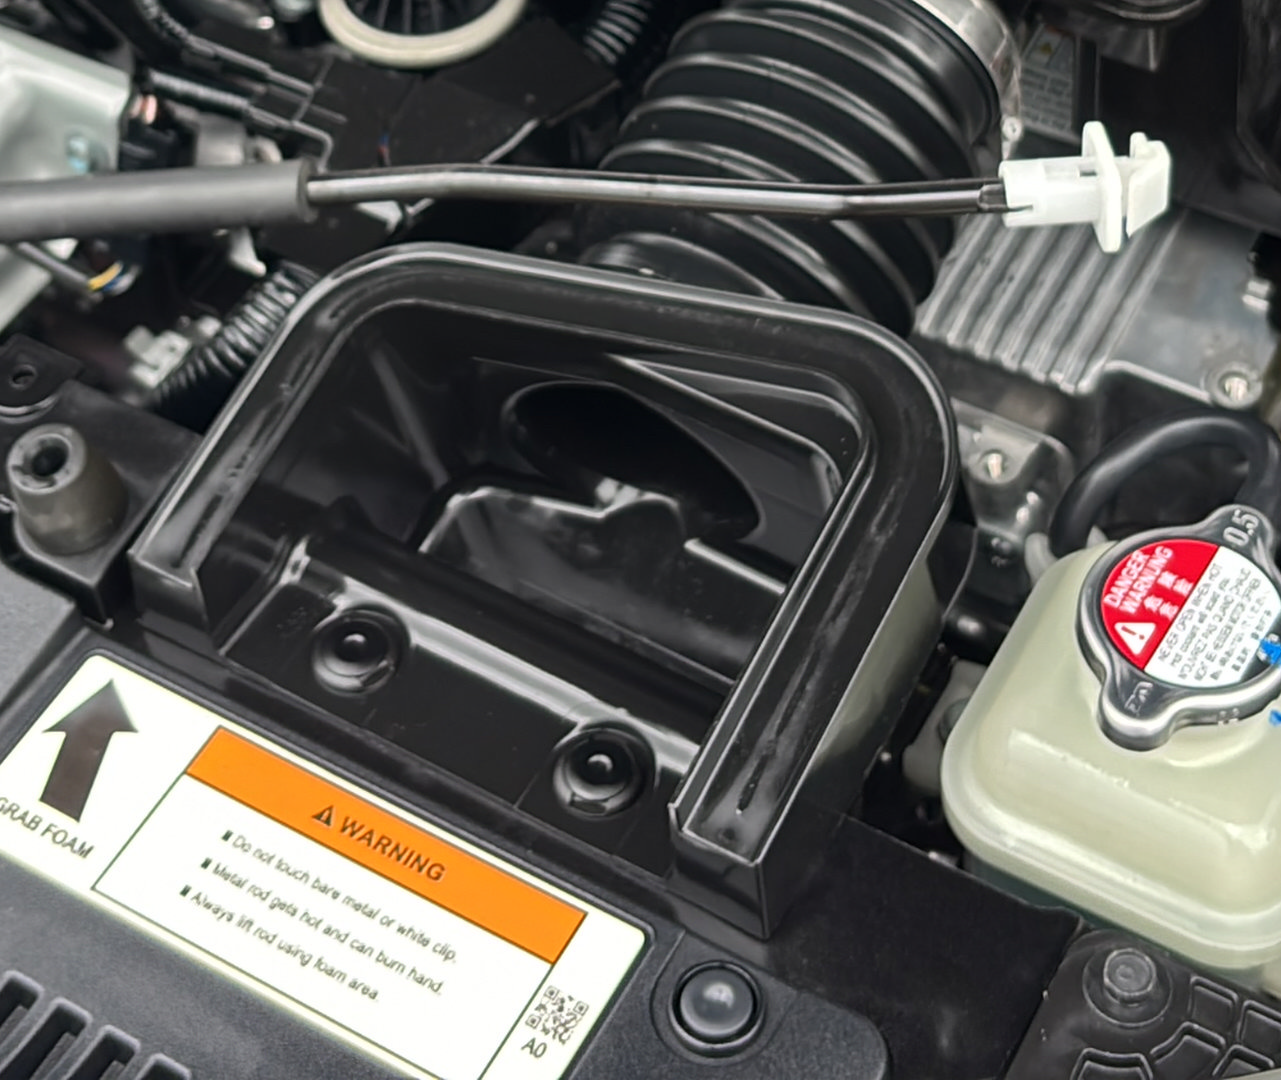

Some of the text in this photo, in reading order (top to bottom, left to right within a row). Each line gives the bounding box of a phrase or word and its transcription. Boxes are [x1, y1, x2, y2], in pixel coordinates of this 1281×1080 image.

[1222, 508, 1260, 548] 0.5
[1102, 549, 1150, 609] DANGER
[1119, 546, 1173, 614] WARNUNG
[39, 818, 95, 861] FOAM
[339, 816, 446, 881] WARNING
[212, 863, 444, 993] Metal rod gets hot and can burn hand.
[232, 835, 456, 962] Do not touch bare metal or white clip.
[190, 891, 379, 1000] Always lift rod using foam area.
